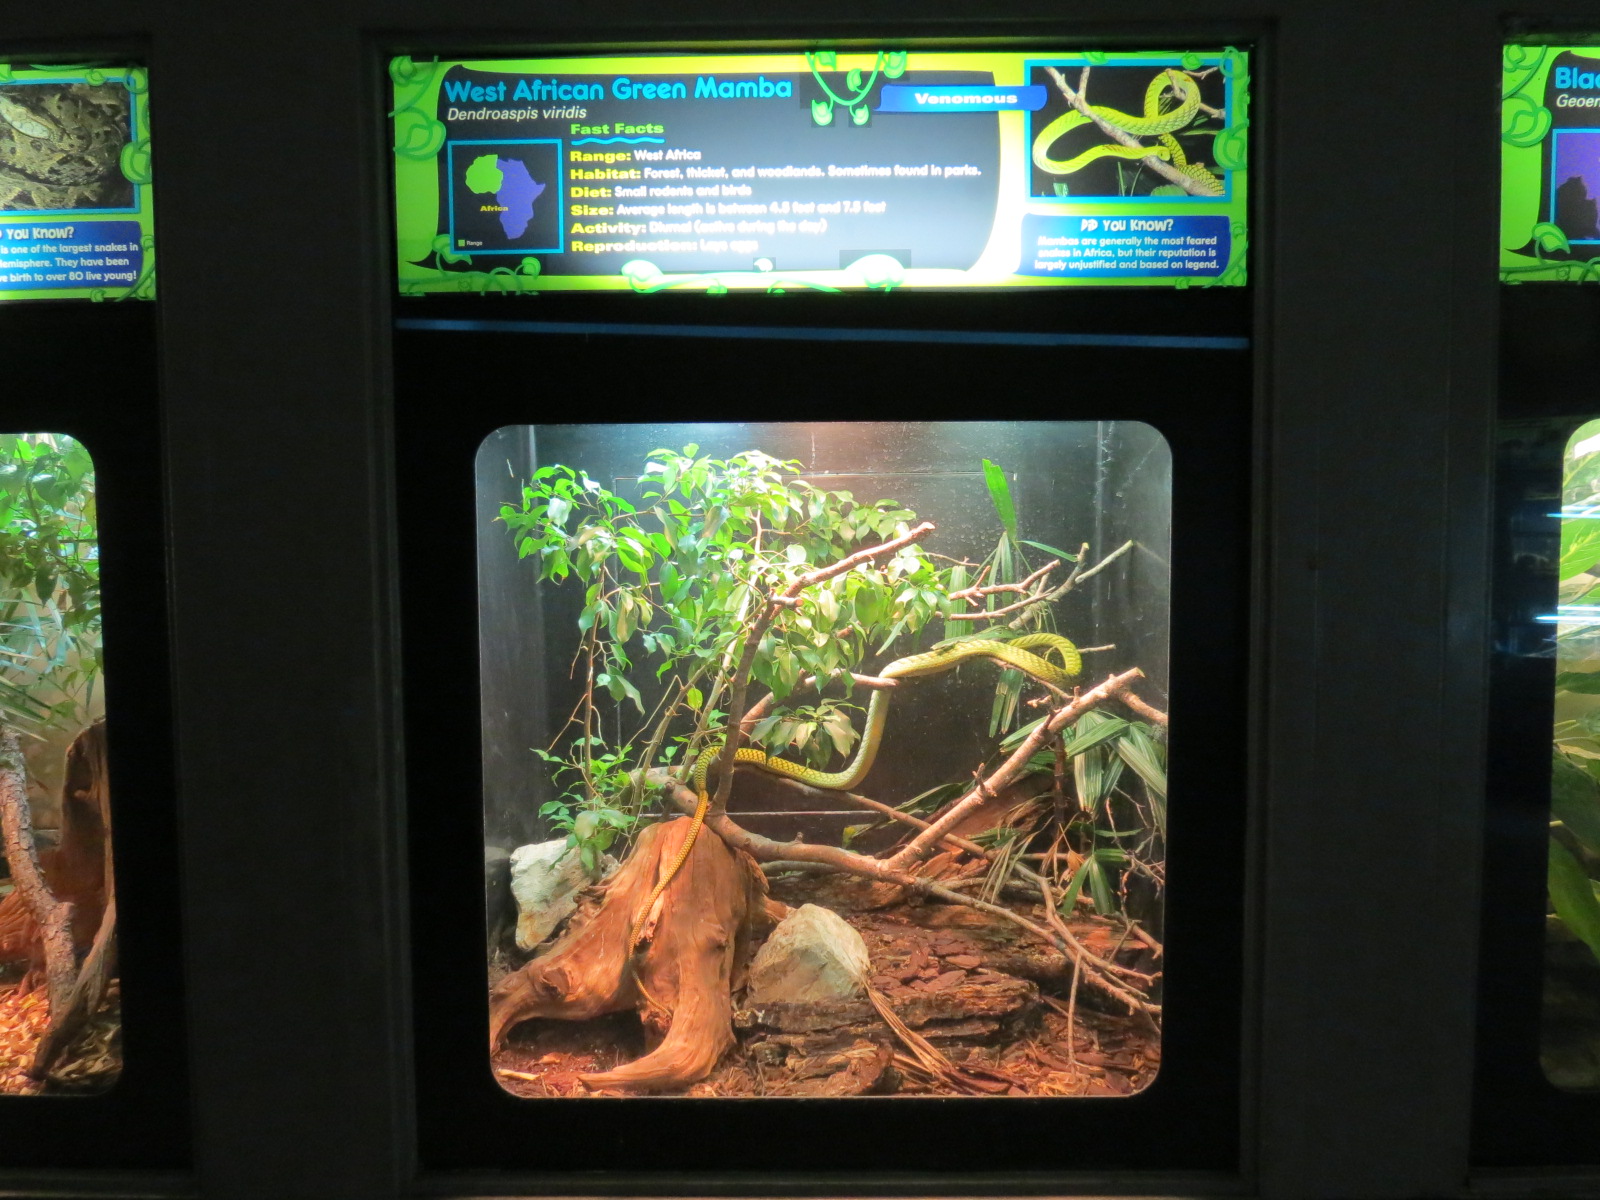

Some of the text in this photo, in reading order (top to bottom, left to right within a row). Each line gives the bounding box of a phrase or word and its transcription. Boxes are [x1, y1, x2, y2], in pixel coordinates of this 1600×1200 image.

[445, 76, 792, 102] West African Green Mamba
[914, 93, 1018, 105] Venomous
[447, 105, 587, 122] Dendroaspis viridis
[570, 123, 664, 135] Fast Facts
[570, 149, 702, 164] Range: West Africa
[570, 168, 641, 180] Habitat:
[644, 167, 684, 180] Forest,
[731, 165, 755, 178] and
[757, 165, 825, 178] woodlands.
[828, 164, 892, 177] Sometimes
[894, 164, 928, 176] found
[930, 164, 942, 176] in
[944, 164, 982, 179] parks.
[570, 184, 752, 198] Diet: Small rodents and birds
[570, 204, 614, 216] Size:
[616, 203, 665, 217] Average
[667, 203, 704, 217] length
[718, 202, 768, 215] between
[571, 221, 647, 235] Activity:
[649, 220, 692, 233] Diurnal
[1, 242, 139, 254] is one of the largest snakes in
[571, 239, 698, 253] Reproduction:
[1037, 235, 1217, 248] Mambas are generally the most feared
[1038, 247, 1217, 259] snakes in Africa, but their reputation is
[55, 257, 79, 268] They
[80, 257, 104, 267] have
[105, 256, 130, 266] been
[1034, 259, 1220, 271] largely unjustified and based on legend.
[10, 272, 32, 282] birth
[34, 272, 44, 281] to
[46, 273, 67, 281] over
[69, 271, 84, 281] 80
[86, 271, 102, 280] live
[104, 270, 137, 282] young!
